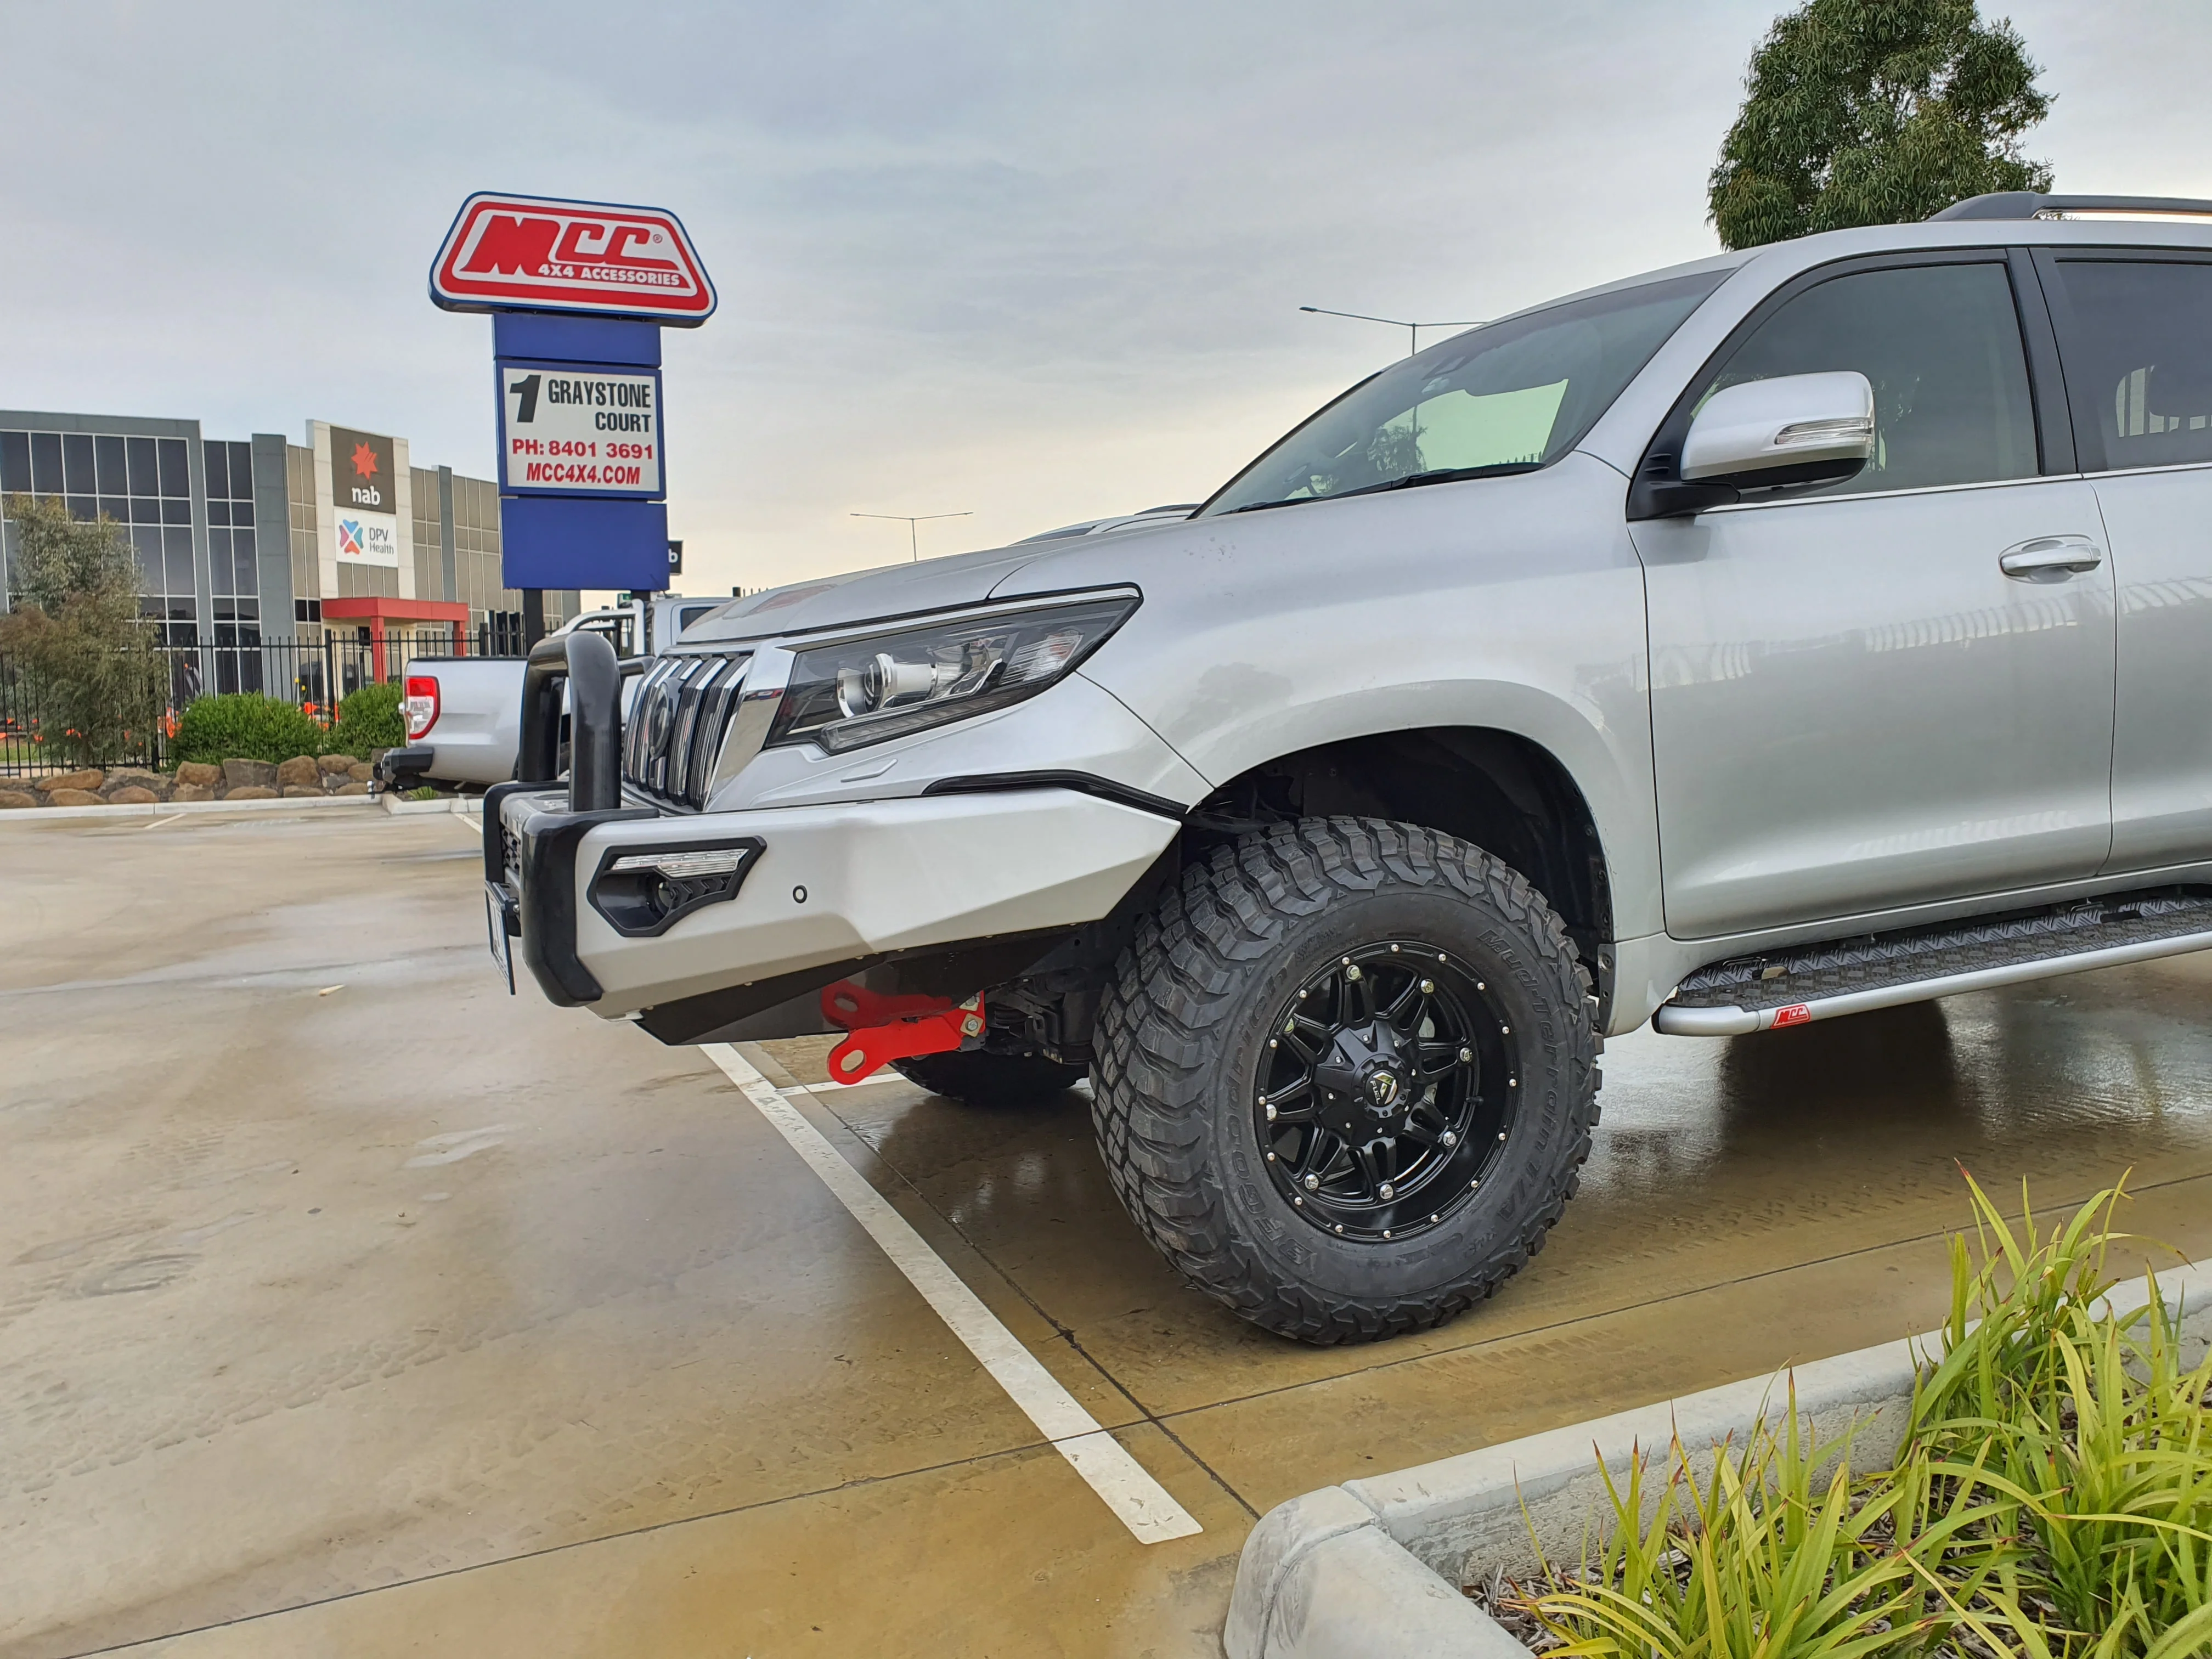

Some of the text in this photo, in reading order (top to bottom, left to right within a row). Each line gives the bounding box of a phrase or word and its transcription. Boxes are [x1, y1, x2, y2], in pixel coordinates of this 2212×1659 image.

[459, 215, 680, 276] MCC
[538, 264, 680, 286] 4X4 ACCESSORIES
[509, 374, 652, 423] 1 GRAYSTONE
[595, 411, 652, 432] COURT
[512, 438, 653, 460] PH: 8401 3691
[526, 462, 641, 485] MCC4X4.COM
[352, 486, 381, 506] nab
[369, 527, 388, 541] DPV
[369, 542, 394, 555] Health
[1370, 1080, 1381, 1104] FUEL
